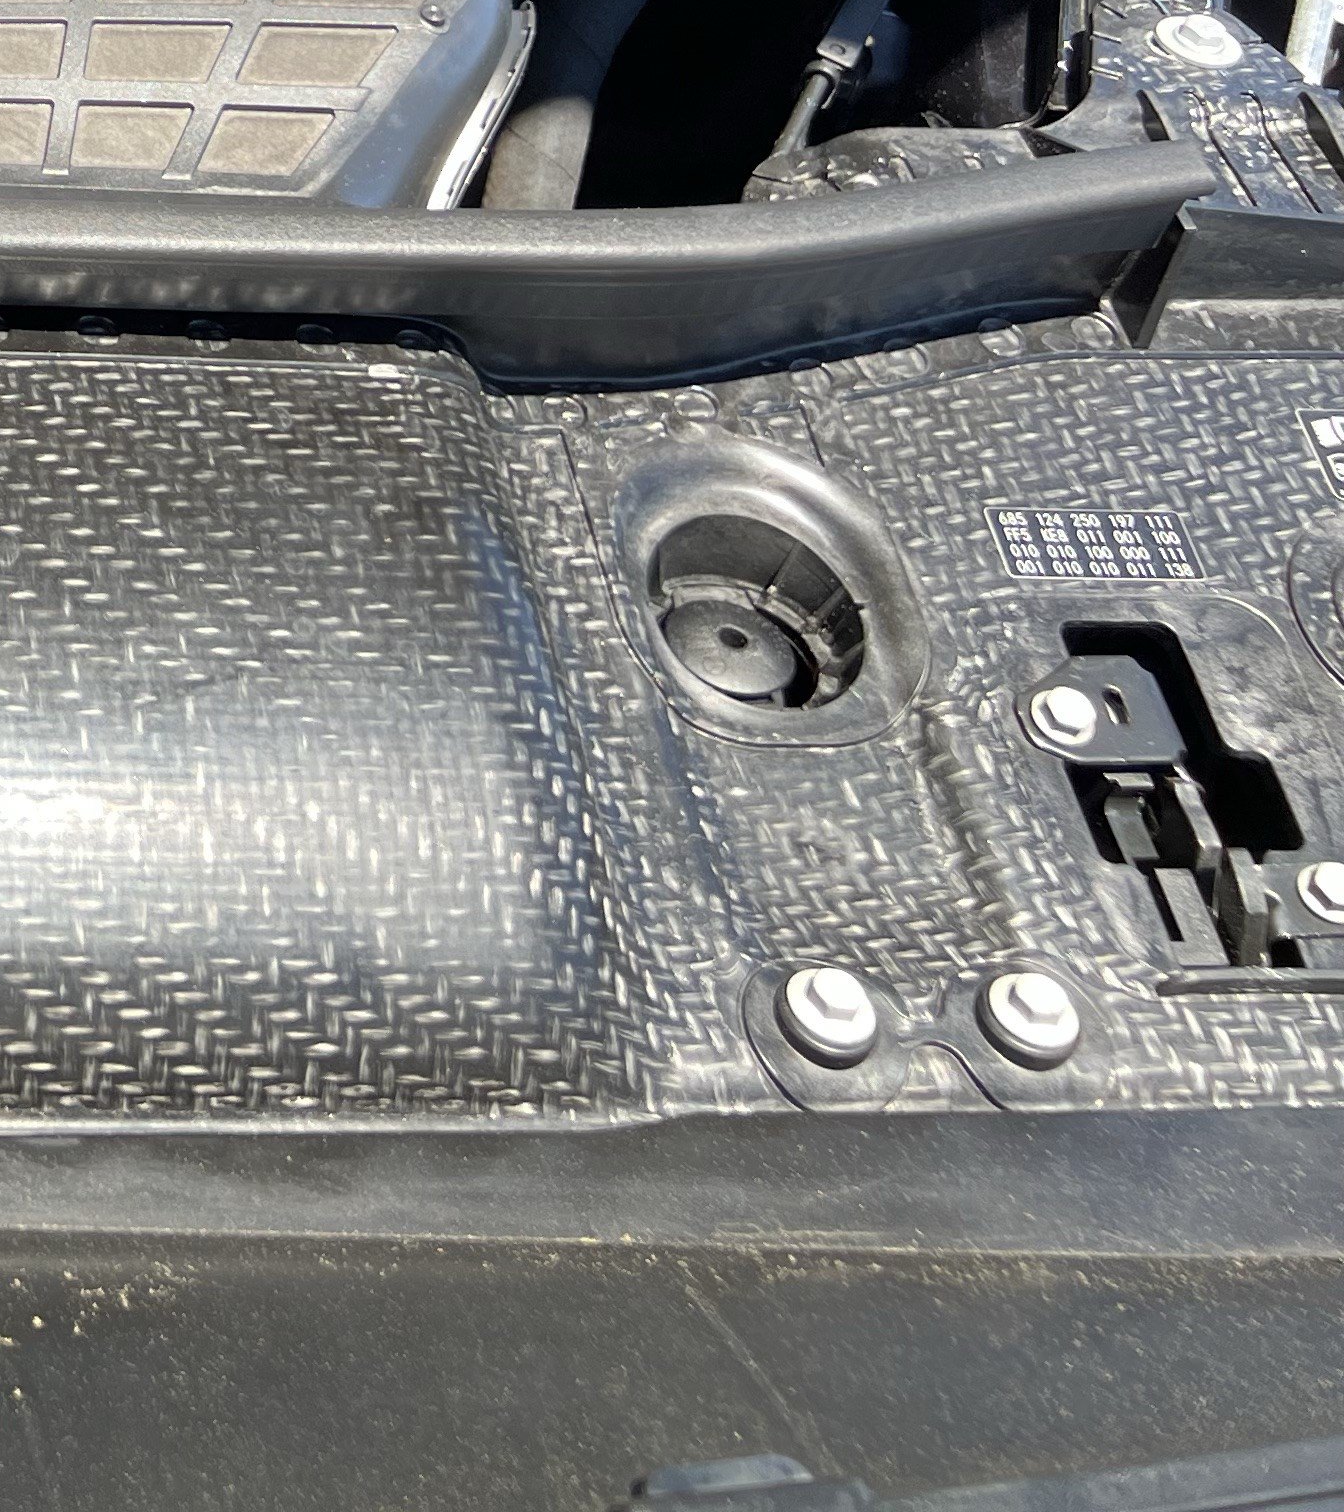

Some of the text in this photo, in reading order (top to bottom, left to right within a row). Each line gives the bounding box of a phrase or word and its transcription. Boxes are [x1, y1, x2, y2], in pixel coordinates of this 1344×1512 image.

[999, 512, 1172, 530] 685 124 250 197 111
[1077, 530, 1106, 544] 011
[1113, 531, 1142, 545] 001
[1151, 531, 1180, 546] 100
[1010, 544, 1186, 562] 010 010 100 000 111
[1016, 560, 1045, 575] 001
[1053, 561, 1083, 575] 010
[1090, 561, 1120, 576] 010
[1127, 562, 1156, 577] 011
